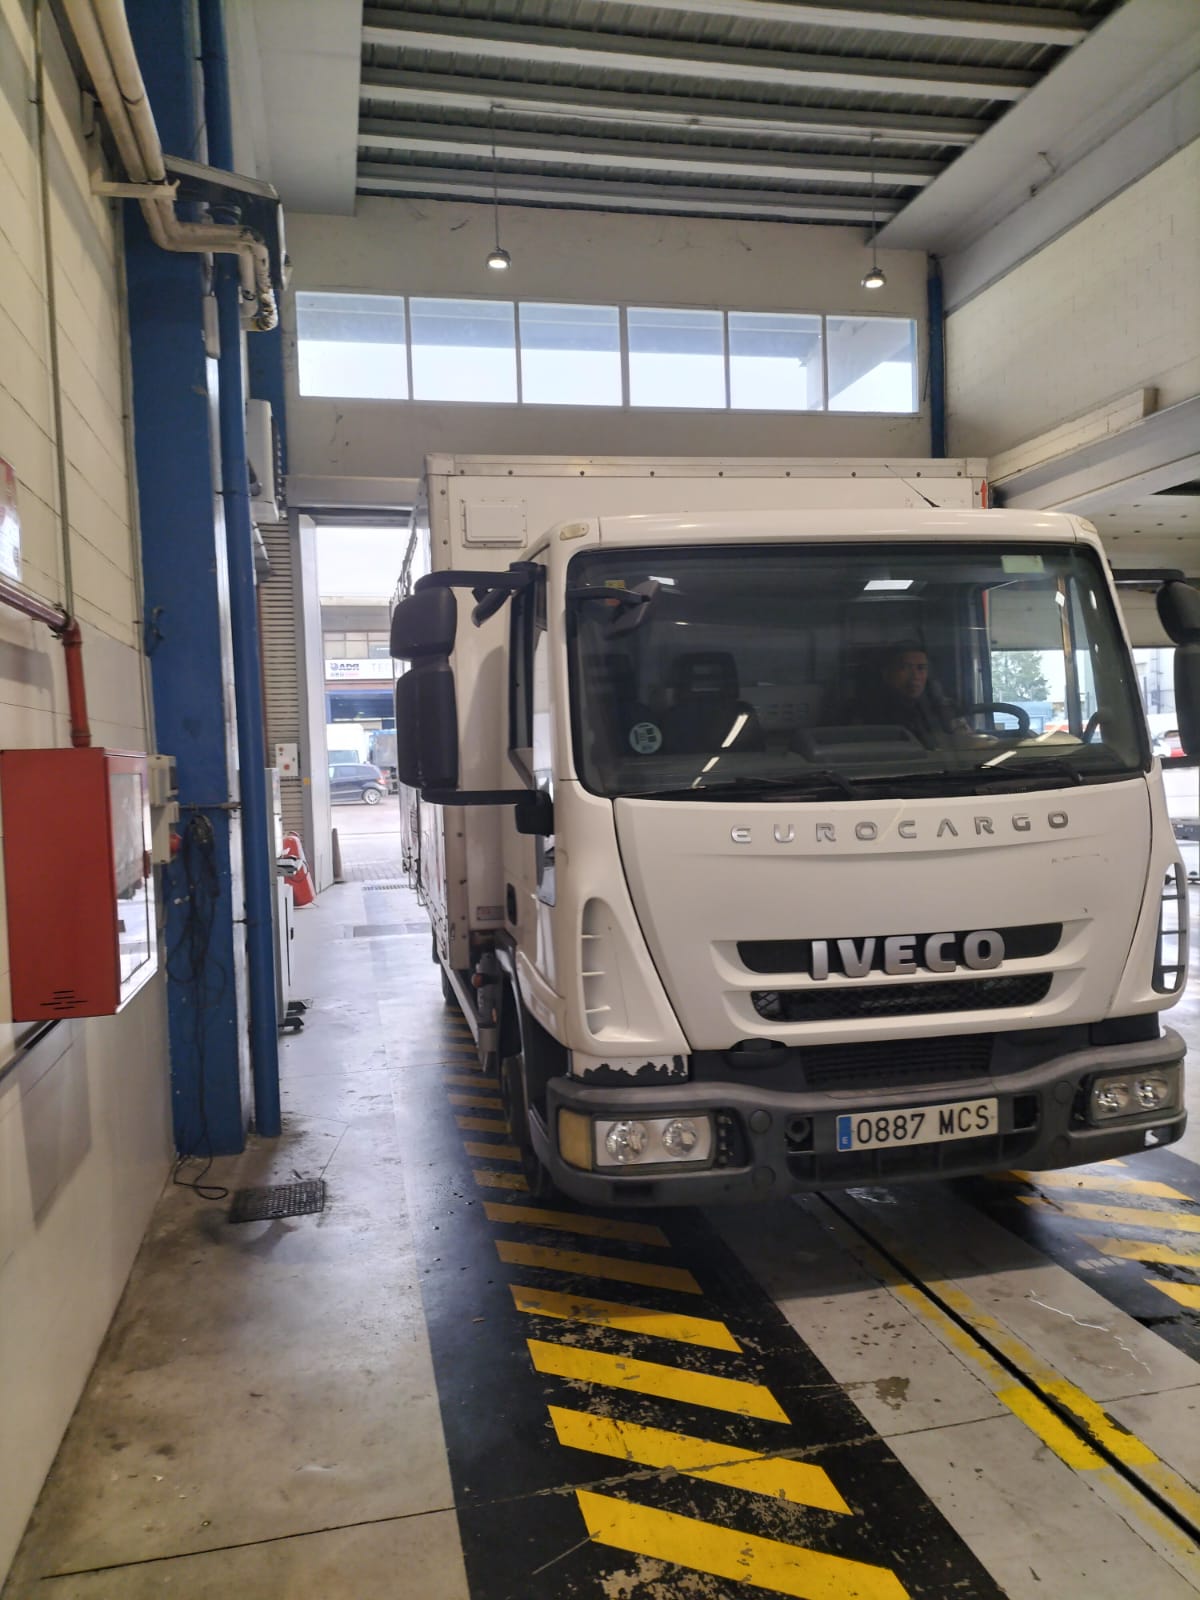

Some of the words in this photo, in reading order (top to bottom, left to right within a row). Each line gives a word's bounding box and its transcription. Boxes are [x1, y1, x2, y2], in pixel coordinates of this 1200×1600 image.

[730, 810, 1069, 845] EUROCARGO
[809, 929, 1005, 981] IVECO
[841, 1136, 849, 1145] E
[856, 1112, 925, 1144] 0887
[938, 1104, 990, 1136] MCS
